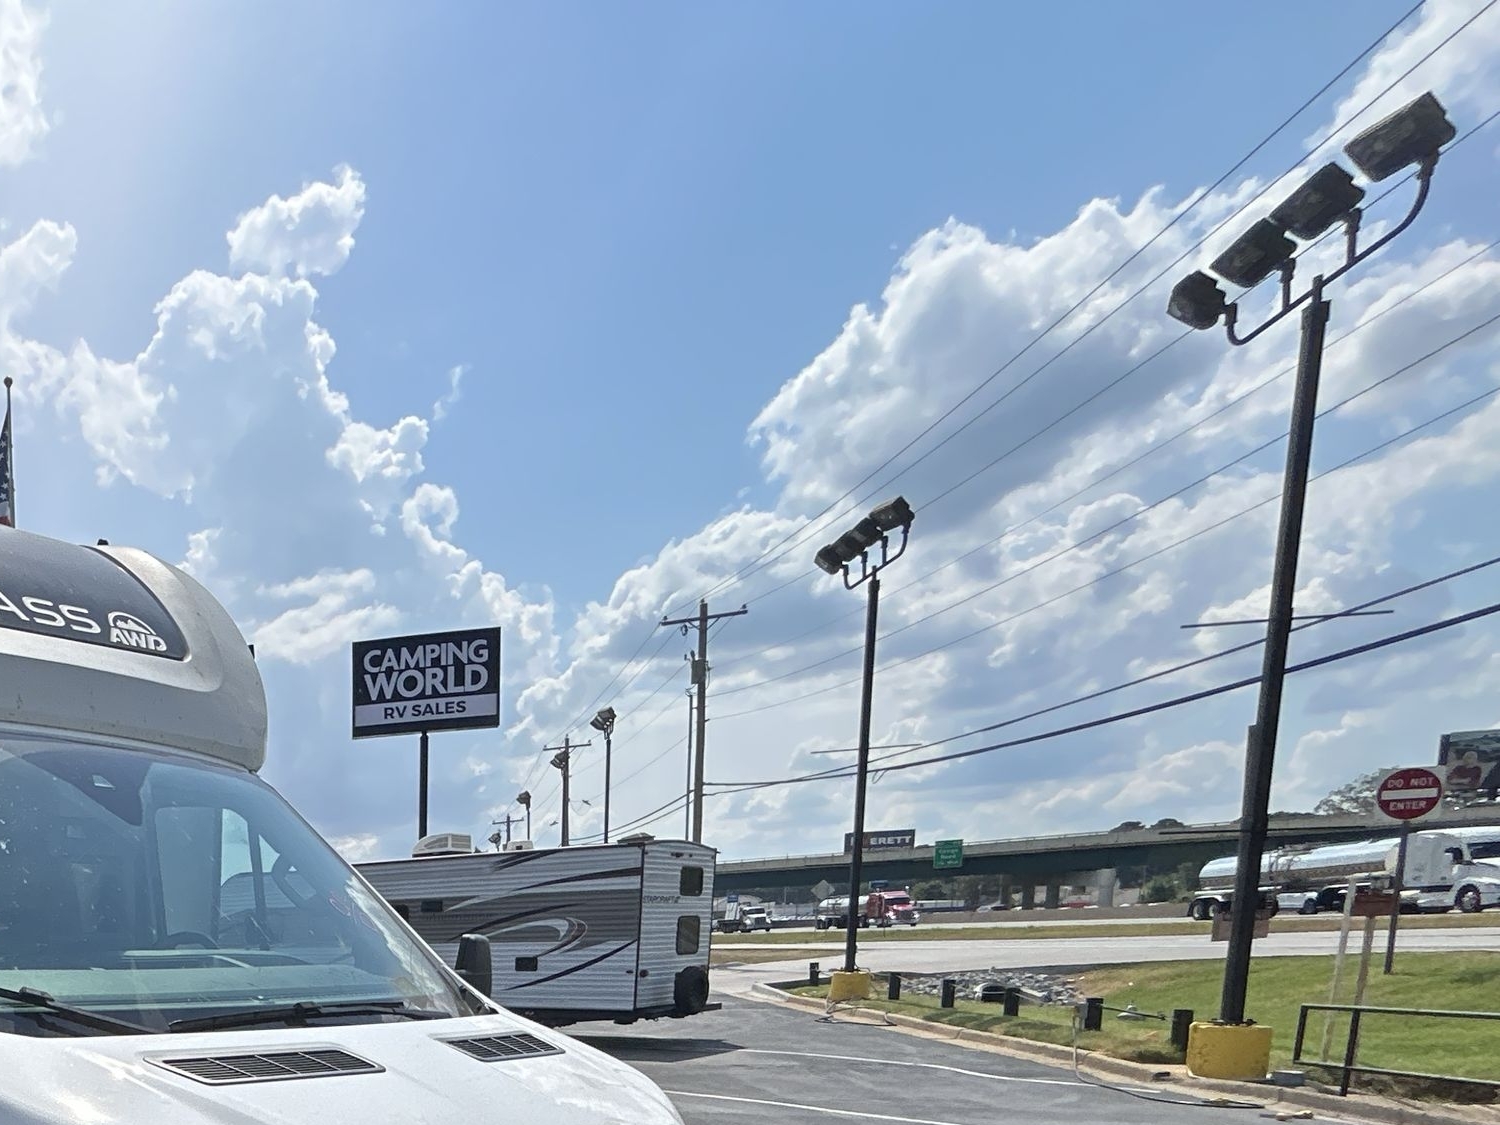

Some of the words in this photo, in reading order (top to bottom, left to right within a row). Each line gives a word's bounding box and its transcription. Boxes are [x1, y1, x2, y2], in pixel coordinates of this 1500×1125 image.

[108, 627, 168, 653] AWD
[363, 638, 490, 673] CAMPING
[363, 663, 490, 701] WORLD
[383, 704, 407, 720] RV
[411, 700, 467, 717] SALES
[1387, 779, 1404, 788] DO
[1410, 777, 1434, 786] NOT
[1389, 801, 1427, 811] ENTER
